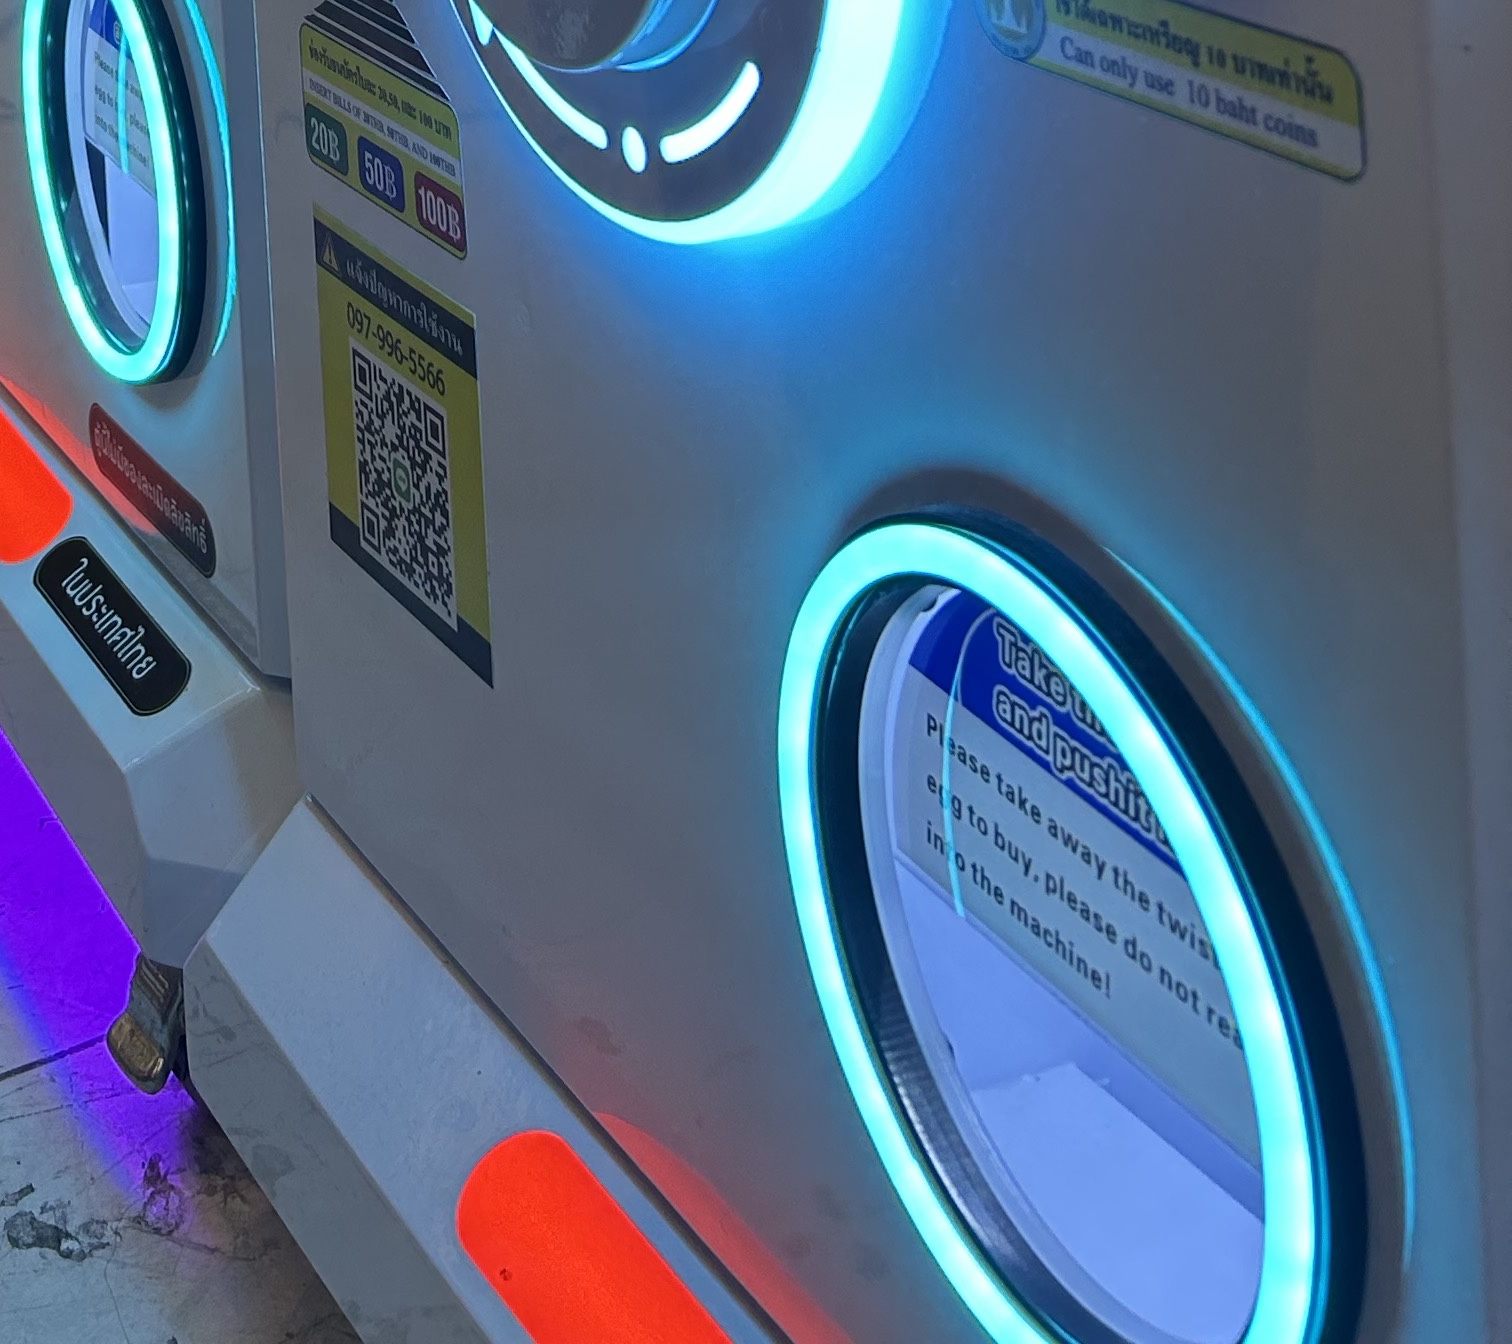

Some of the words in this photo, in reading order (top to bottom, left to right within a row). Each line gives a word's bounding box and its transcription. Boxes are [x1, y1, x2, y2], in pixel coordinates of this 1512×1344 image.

[1060, 37, 1095, 69] Can
[1099, 54, 1140, 87] only
[1144, 71, 1176, 97] use
[1187, 80, 1211, 109] 10
[1215, 87, 1259, 126] baht
[1262, 108, 1319, 148] coins
[346, 302, 446, 397] 097-996-5566
[62, 556, 158, 681] ในประเทศไทย
[994, 618, 1068, 707] Take
[992, 686, 1050, 755] and
[927, 713, 991, 785] Please
[996, 771, 1042, 823] take
[1047, 818, 1108, 883] away
[1113, 865, 1150, 913] the
[968, 801, 989, 836] to
[992, 823, 1040, 884] buy,
[1045, 873, 1118, 942] please
[1124, 936, 1153, 973] do
[1159, 964, 1202, 1014] not
[971, 862, 1004, 905] the
[1010, 897, 1112, 1000] machine!
